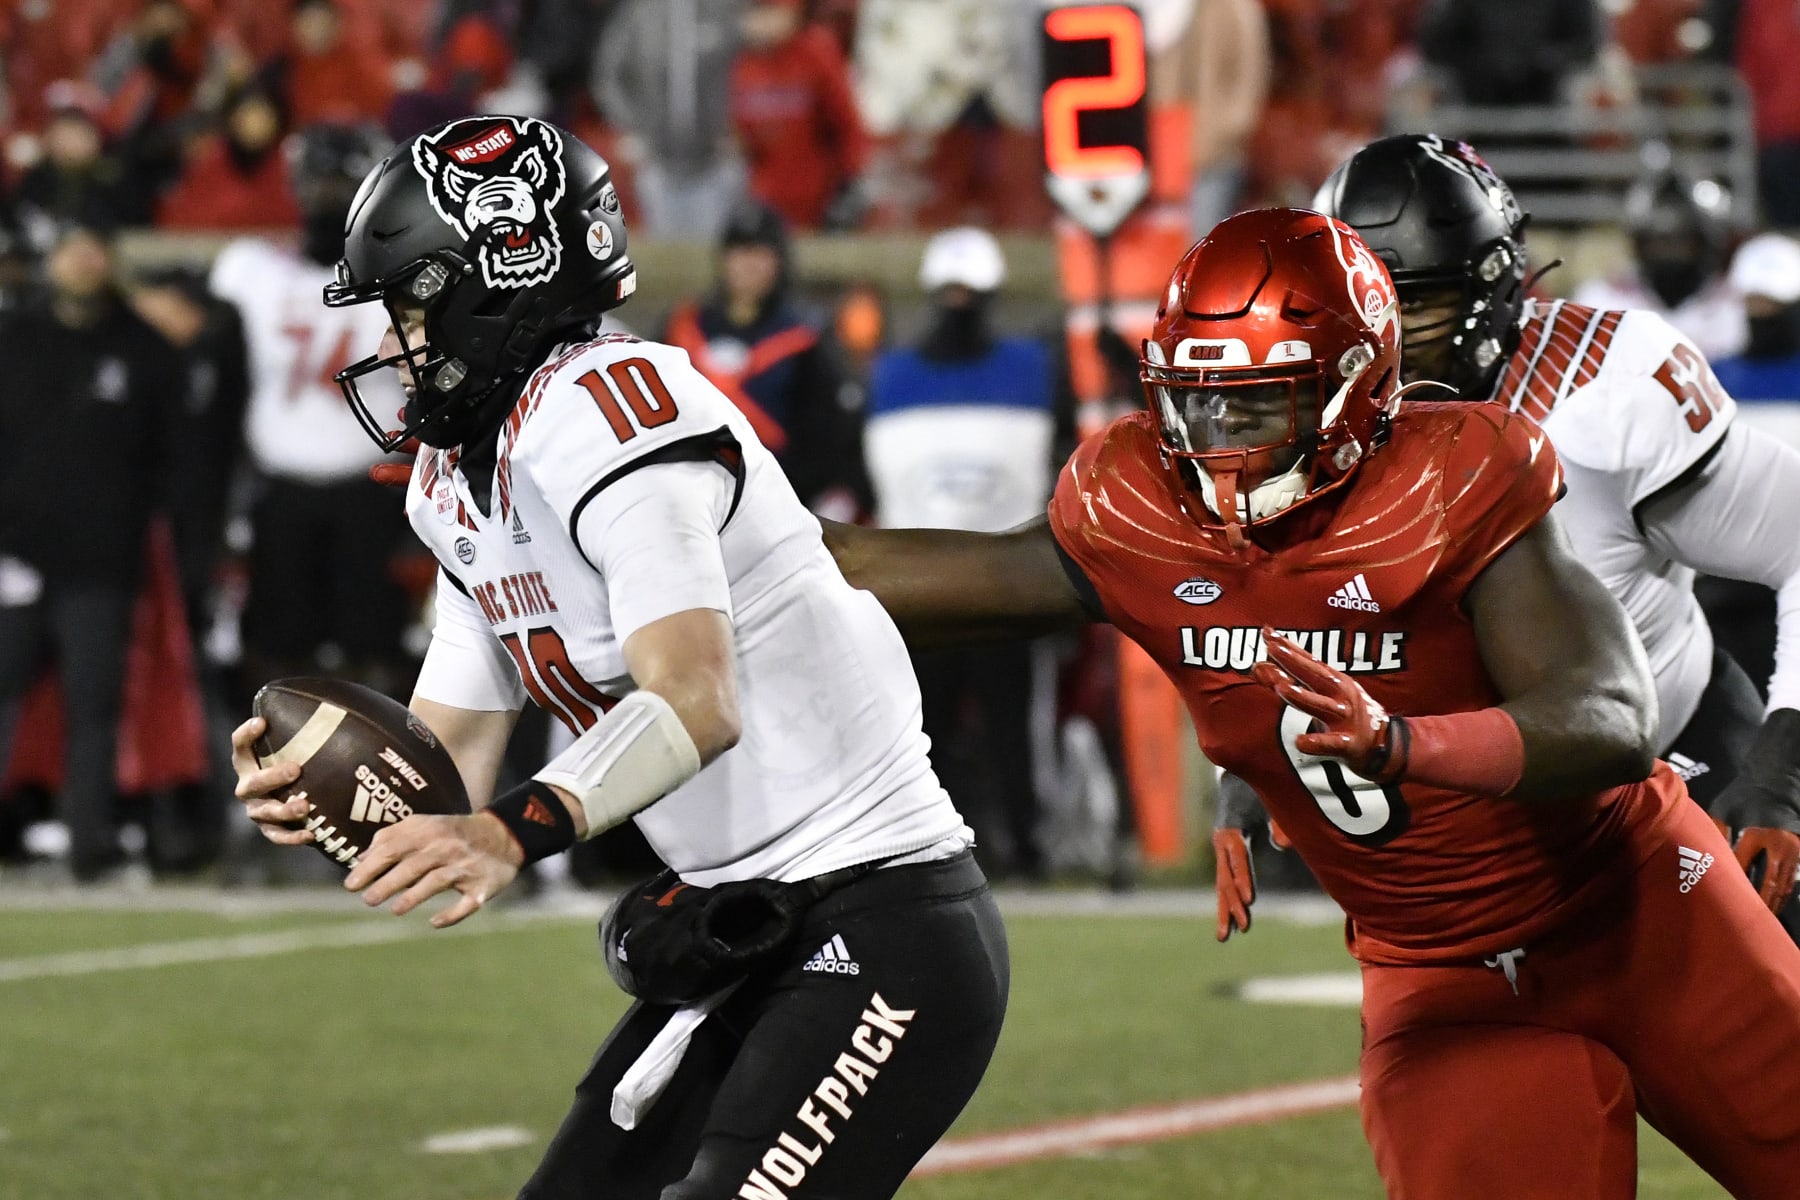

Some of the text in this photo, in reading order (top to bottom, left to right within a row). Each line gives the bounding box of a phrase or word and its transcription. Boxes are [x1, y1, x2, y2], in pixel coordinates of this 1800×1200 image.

[1043, 5, 1147, 179] 2
[455, 129, 512, 162] NC STATE
[1189, 345, 1227, 360] CARDS
[1283, 343, 1296, 357] L
[573, 357, 679, 444] 10
[1652, 342, 1727, 434] 52
[458, 541, 472, 555] ACC
[472, 571, 558, 626] NC STATE
[1180, 584, 1215, 595] ACC
[1327, 594, 1380, 613] adidas
[499, 626, 622, 738] 10
[377, 746, 428, 791] DIME
[1279, 703, 1395, 837] 0
[354, 764, 414, 820] adidas
[1679, 852, 1714, 894] adidas
[803, 958, 860, 975] adidas
[731, 991, 917, 1200] WOLFPACK
